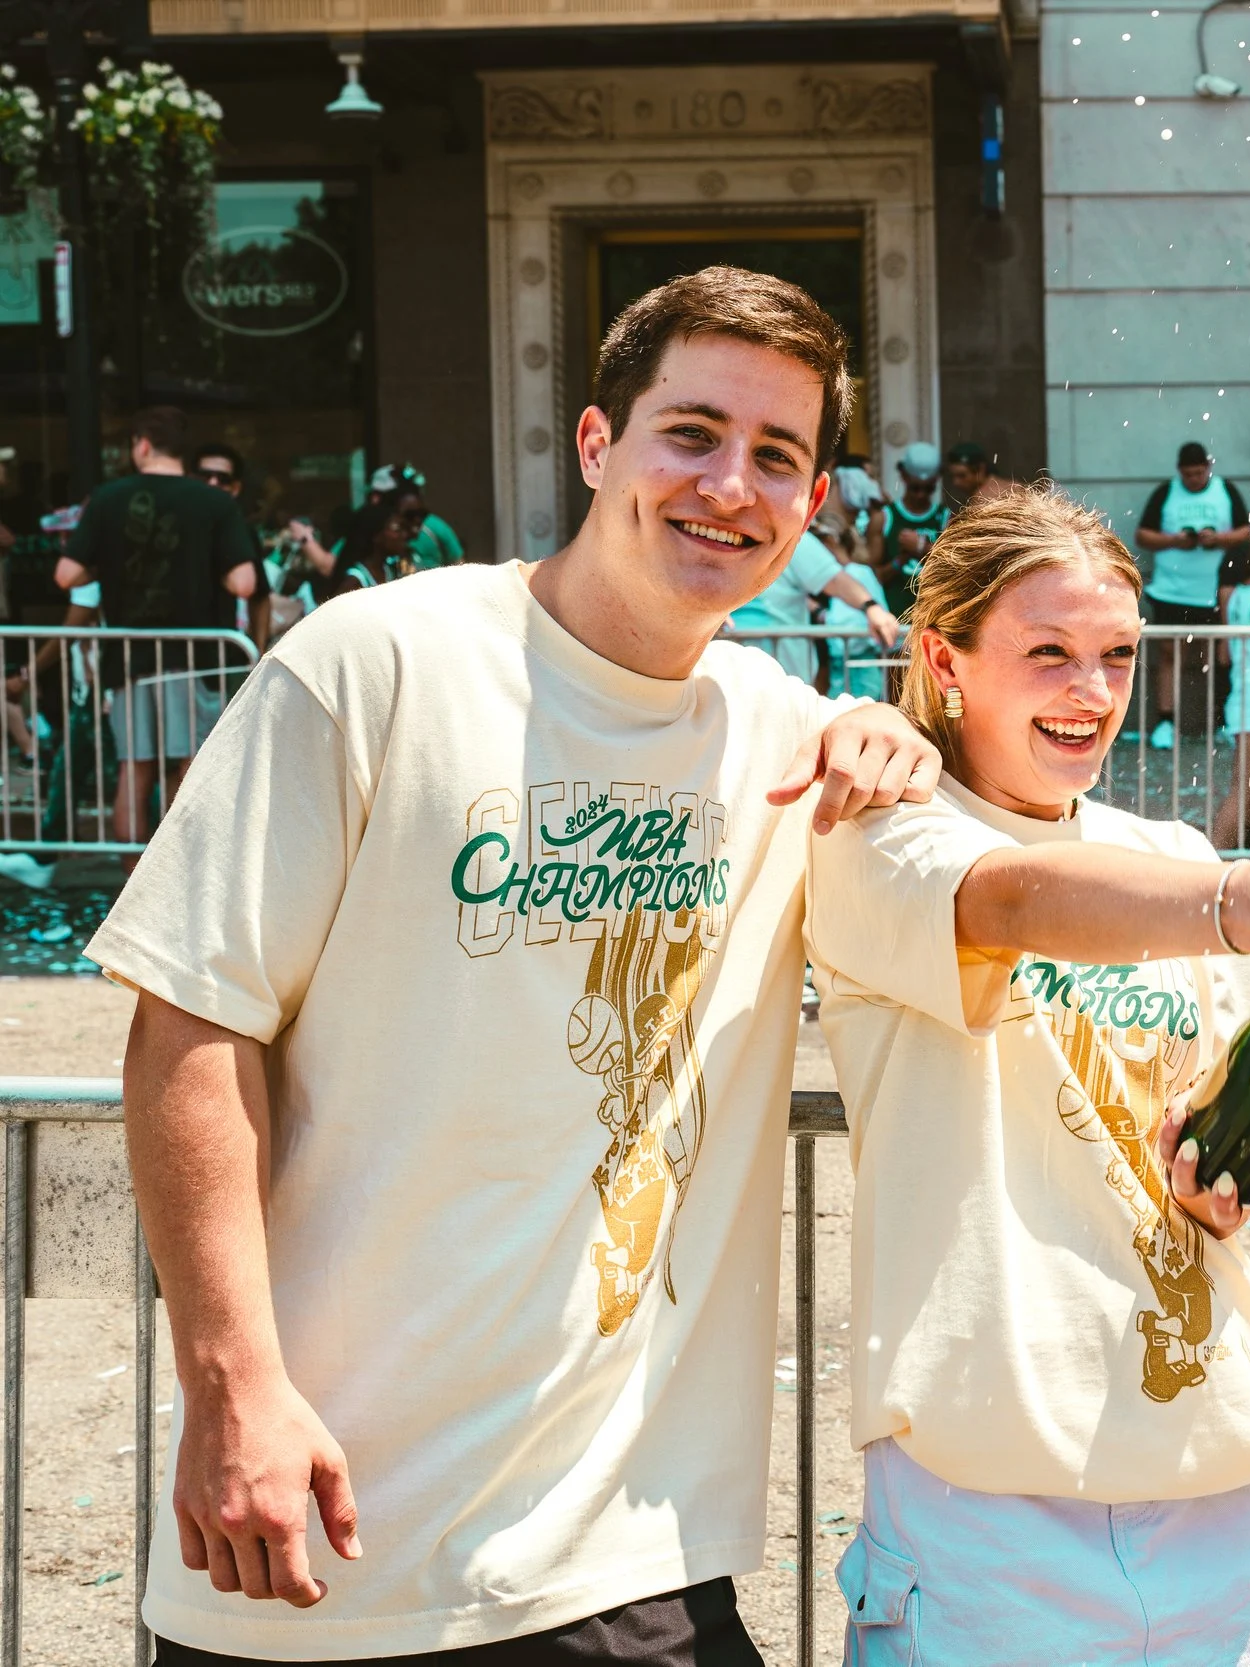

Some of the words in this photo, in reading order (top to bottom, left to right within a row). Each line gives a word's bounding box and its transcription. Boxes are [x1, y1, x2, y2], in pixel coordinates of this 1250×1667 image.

[669, 88, 746, 130] 180
[205, 284, 282, 307] wers
[540, 807, 691, 862] NBA
[564, 794, 609, 834] 2024
[451, 831, 730, 923] CHAMPIONS
